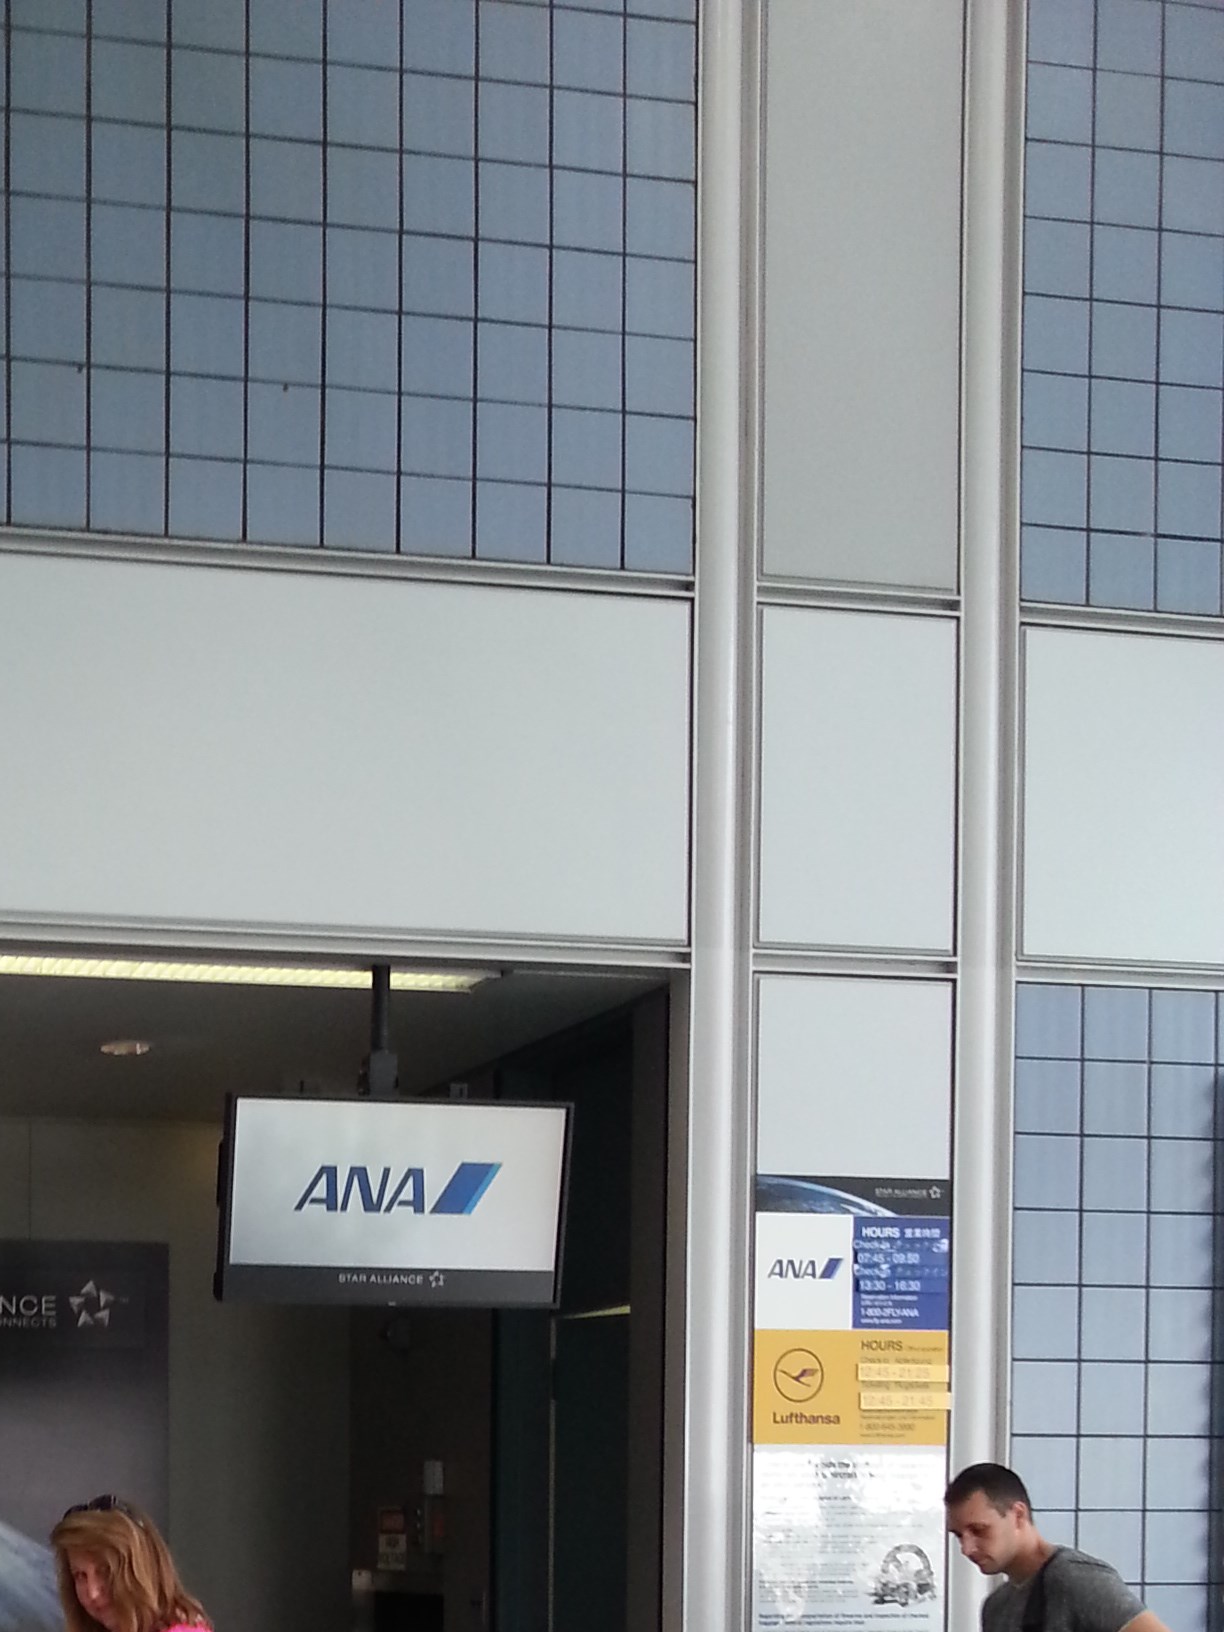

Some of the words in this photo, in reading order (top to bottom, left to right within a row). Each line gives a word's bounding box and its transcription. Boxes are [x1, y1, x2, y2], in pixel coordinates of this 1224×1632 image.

[294, 1165, 425, 1214] ANA
[861, 1226, 900, 1238] HOURS
[768, 1259, 817, 1279] ANA
[338, 1273, 367, 1283] STAR
[370, 1273, 423, 1284] ALLIANCE
[861, 1340, 903, 1351] HOURS
[772, 1411, 841, 1425] Lufthansa
